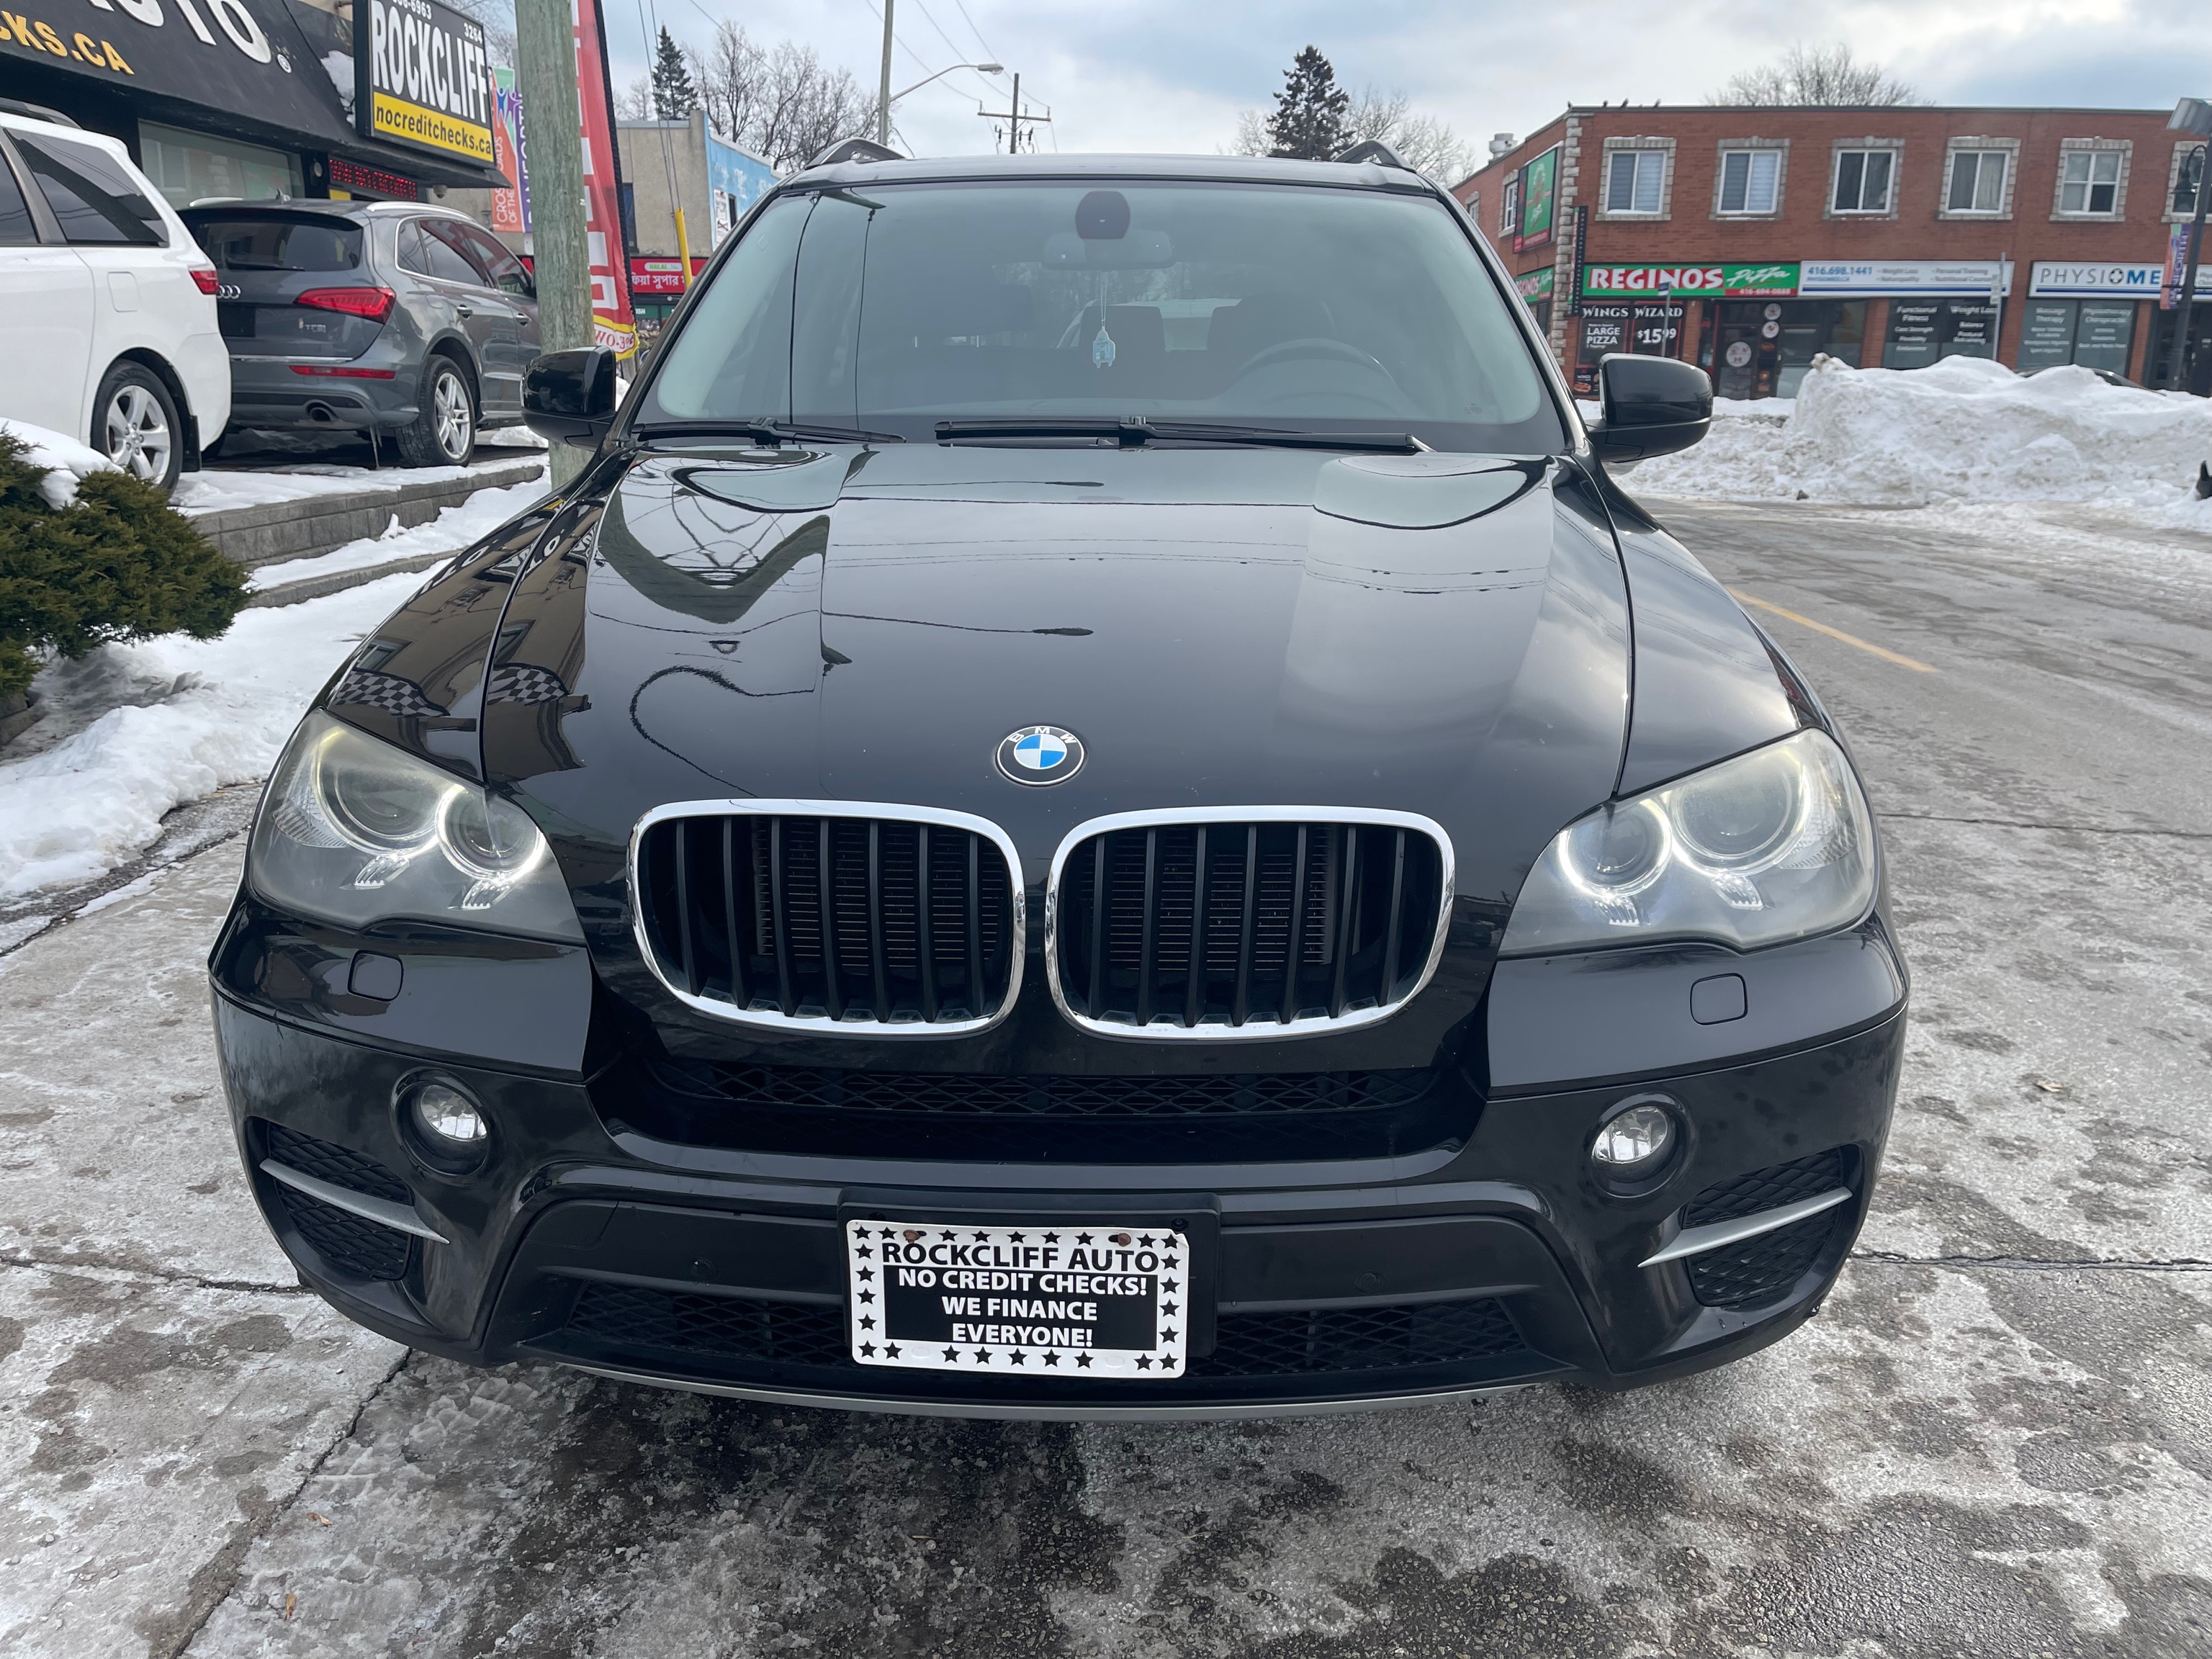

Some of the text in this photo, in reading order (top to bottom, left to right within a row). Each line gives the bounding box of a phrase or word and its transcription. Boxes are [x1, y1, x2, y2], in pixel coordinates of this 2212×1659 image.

[464, 22, 483, 45] 3264
[371, 0, 487, 124] ROCKCLIFF
[376, 105, 492, 154] nocreditchecks.ca
[1589, 266, 1791, 289] REGINOS Pizza
[2040, 268, 2162, 284] PHYSIOME
[1582, 305, 1683, 318] WINGS WIZARD
[1586, 336, 1618, 344] PIZZA
[1587, 327, 1621, 336] LARGE
[1007, 727, 1077, 744] BMW
[882, 1242, 1159, 1272] ROCKCLIFF AUTO
[899, 1269, 1148, 1296] NO CREDIT CHECKS!
[941, 1296, 1098, 1321] WE FINANCE
[951, 1323, 1093, 1348] EVERYONE!
